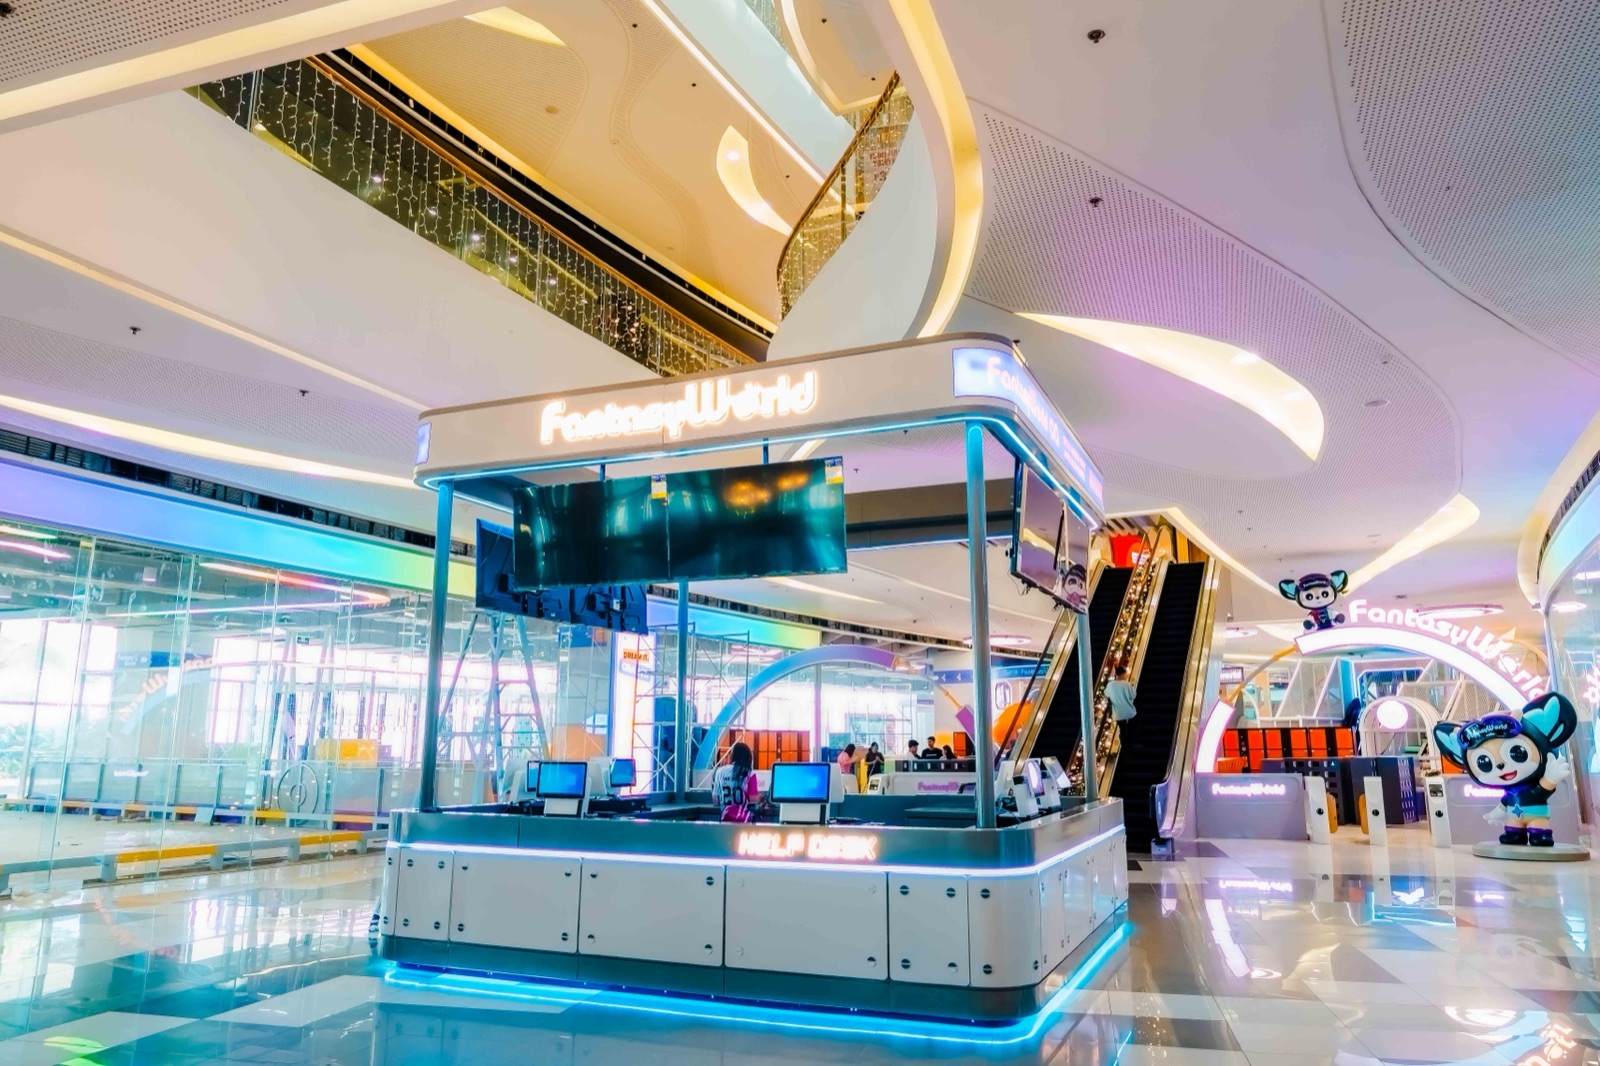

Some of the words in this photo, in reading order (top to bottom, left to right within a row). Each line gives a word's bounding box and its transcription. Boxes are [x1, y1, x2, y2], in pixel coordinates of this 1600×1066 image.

[540, 371, 818, 444] FantasyWorld
[737, 831, 806, 857] HELP
[807, 834, 879, 861] DESK
